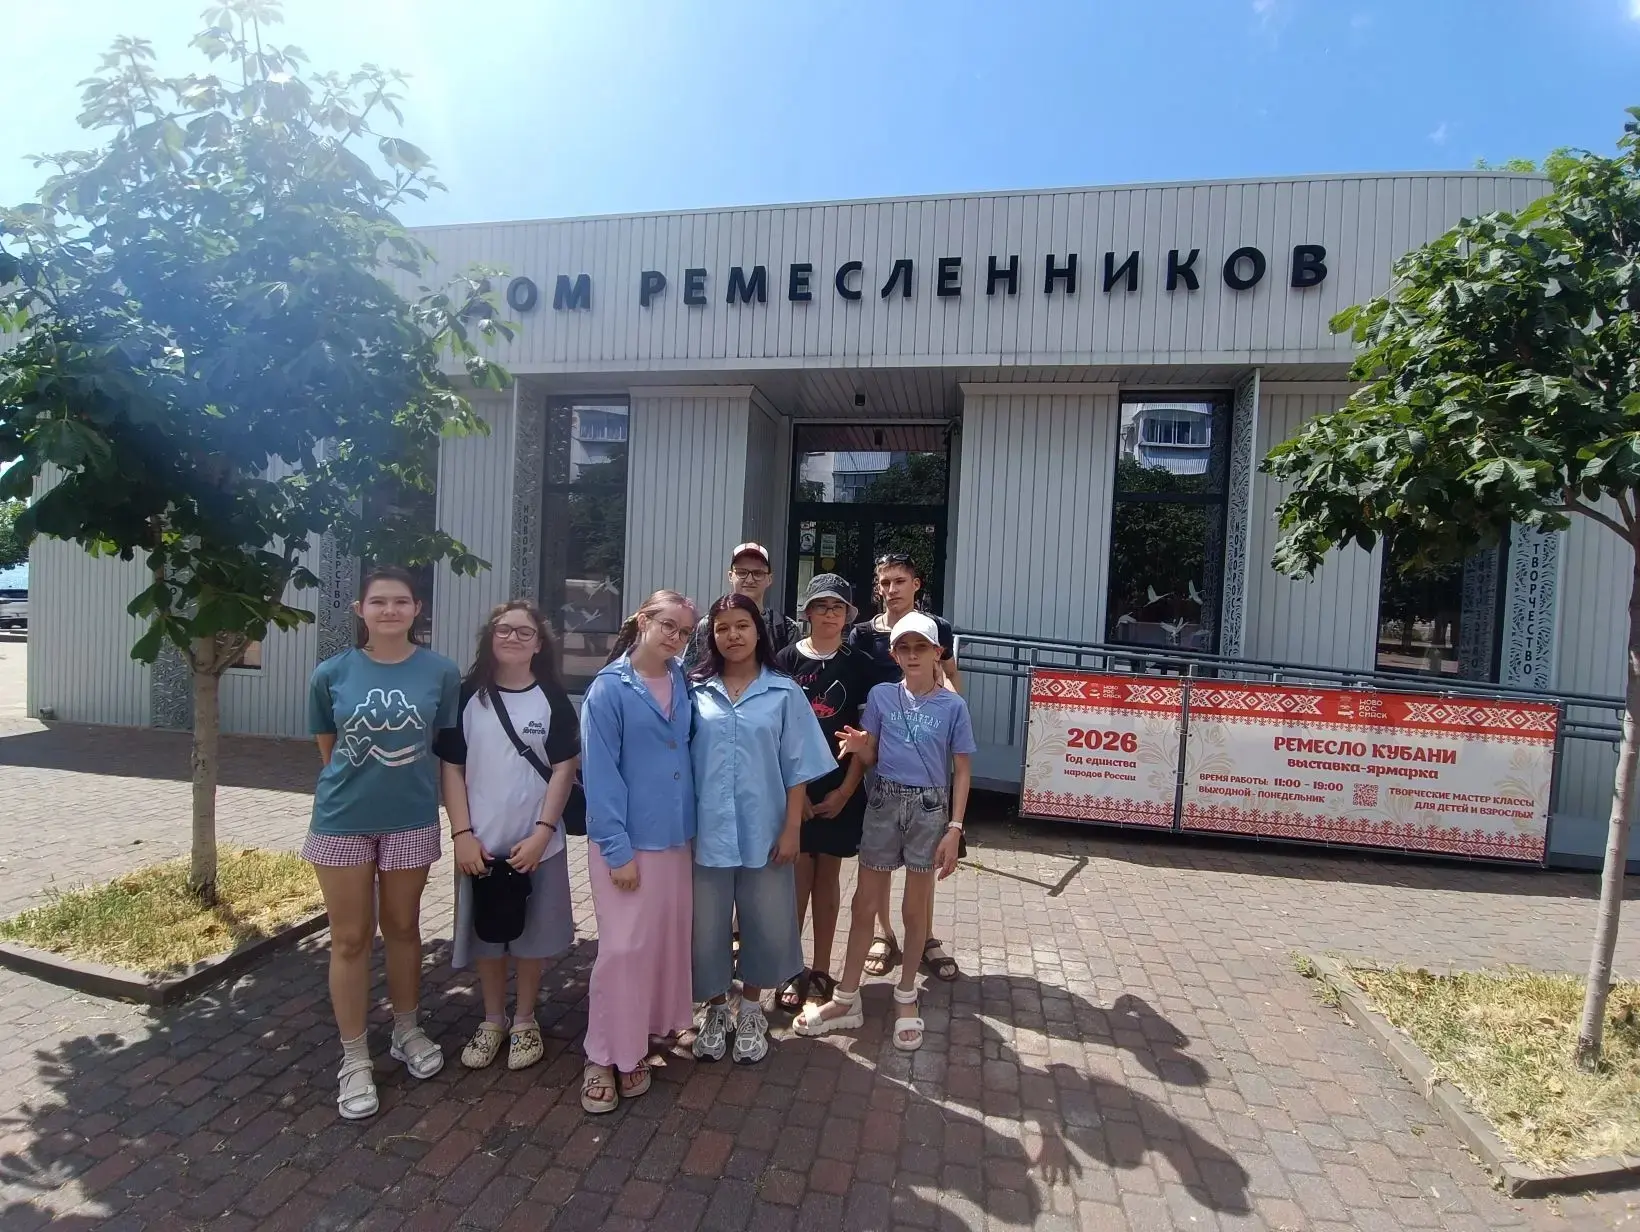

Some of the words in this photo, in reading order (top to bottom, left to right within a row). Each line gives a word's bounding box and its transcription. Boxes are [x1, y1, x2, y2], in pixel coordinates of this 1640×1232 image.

[640, 244, 1328, 307] РЕМЕСЛЕННИКОВ
[1523, 543, 1541, 675] ТВОРЧЕСТВО
[1067, 727, 1138, 753] 2026
[1274, 736, 1367, 759] РЕМЕСЛО
[1371, 743, 1457, 764] КУБАНИ
[1065, 753, 1083, 764] Год
[1085, 756, 1137, 769] единства
[1287, 758, 1439, 780] выставка-ярмарка
[1064, 769, 1103, 779] народов
[1104, 771, 1136, 781] России
[1199, 773, 1229, 783] ВРЕМЯ
[1230, 775, 1269, 786] РАБОТЫ:
[1274, 778, 1301, 788] 11:00
[1313, 781, 1344, 792] 19:00
[1198, 785, 1251, 797] ВЫХОДНОЙ
[1257, 790, 1326, 803] ПОНЕДЕЛЬНИК
[1389, 787, 1451, 800] ТВОРЧЕСКИЕ
[1452, 793, 1492, 804] МАСТЕР
[1493, 797, 1535, 808] КЛАССЫ
[1414, 802, 1436, 811] ДЛЯ
[1437, 802, 1469, 814] ДЕТЕЙ
[1471, 806, 1478, 814] И
[1479, 807, 1534, 819] ВЗРОСЛЫХ
